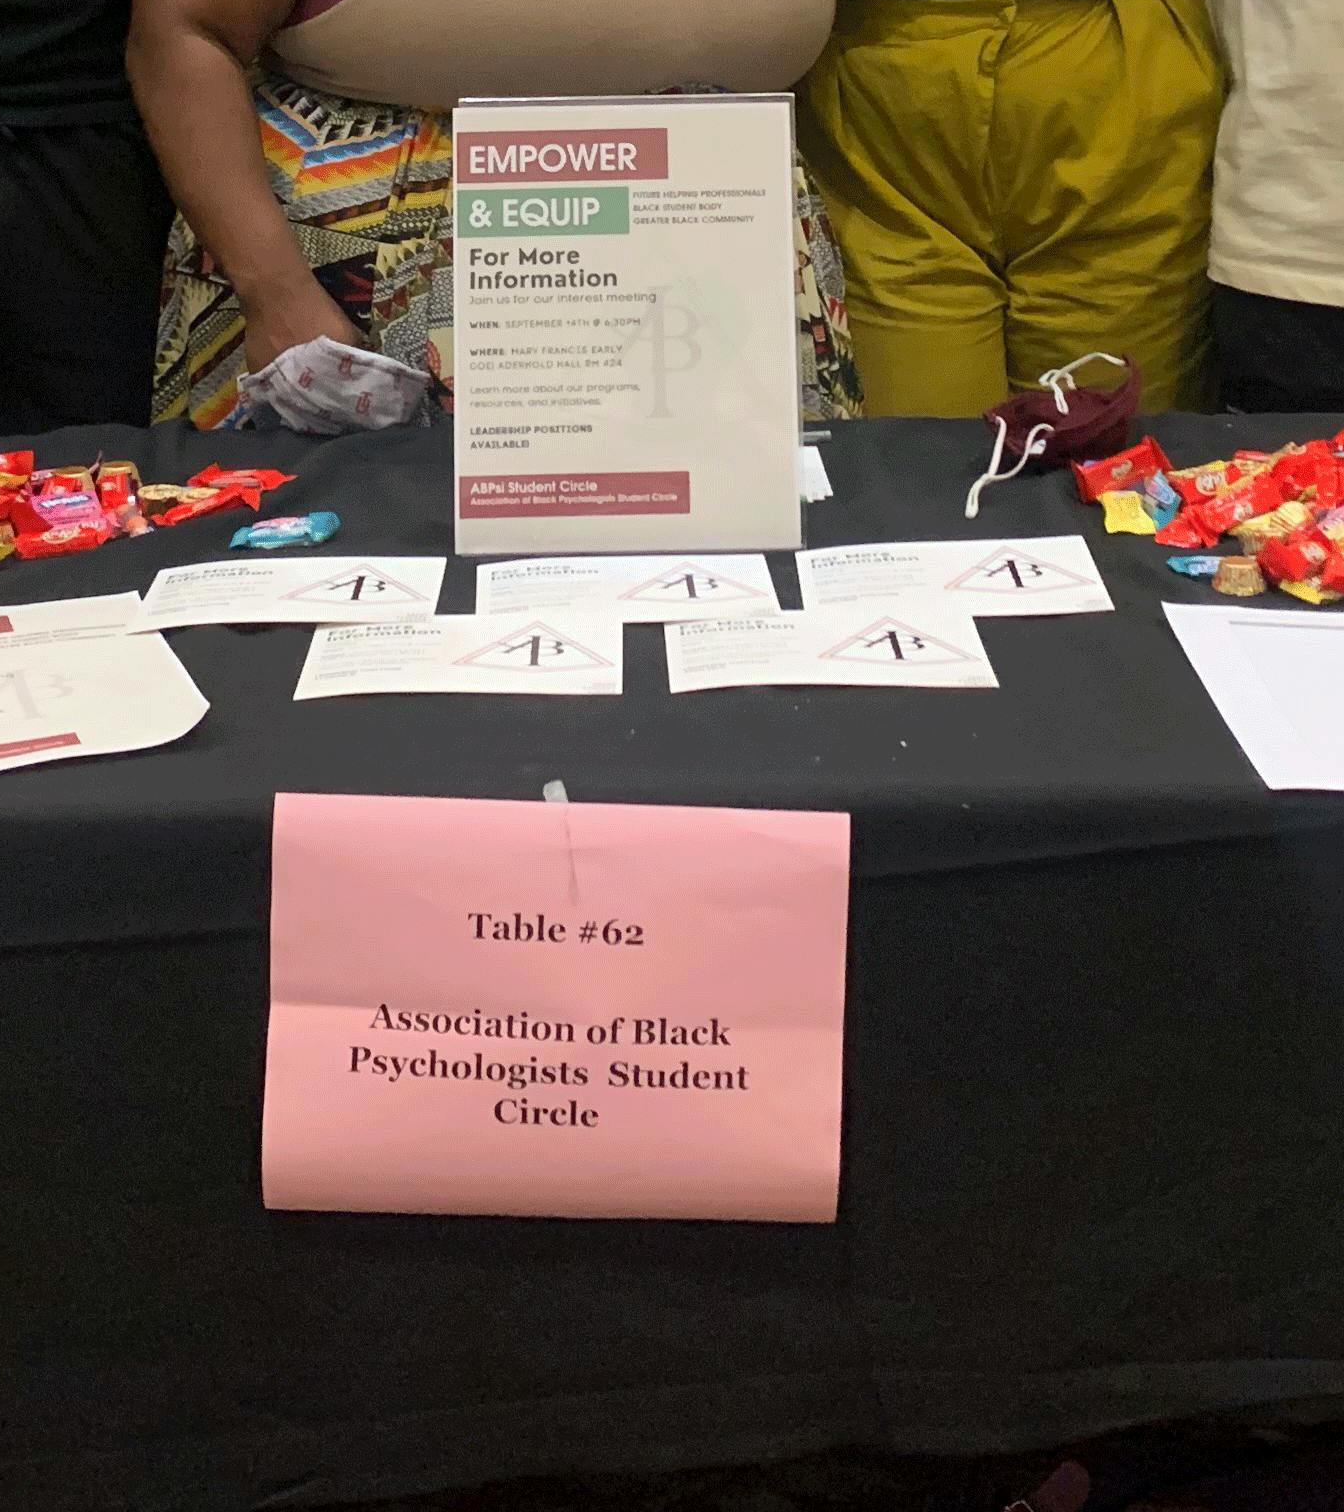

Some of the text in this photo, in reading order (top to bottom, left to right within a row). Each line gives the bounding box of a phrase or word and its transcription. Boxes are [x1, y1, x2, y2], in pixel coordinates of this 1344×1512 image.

[468, 142, 638, 174] EMPOWER
[468, 197, 601, 228] & EQUIP
[469, 248, 580, 267] For More
[469, 269, 618, 290] Information
[469, 292, 657, 305] Join us for our interest meeting
[508, 481, 557, 493] Student
[559, 480, 598, 492] Circle
[468, 912, 646, 946] Table #62
[369, 1004, 732, 1047] Association of Black
[348, 1046, 751, 1091] Psychologists Student
[493, 1098, 600, 1128] Circle
